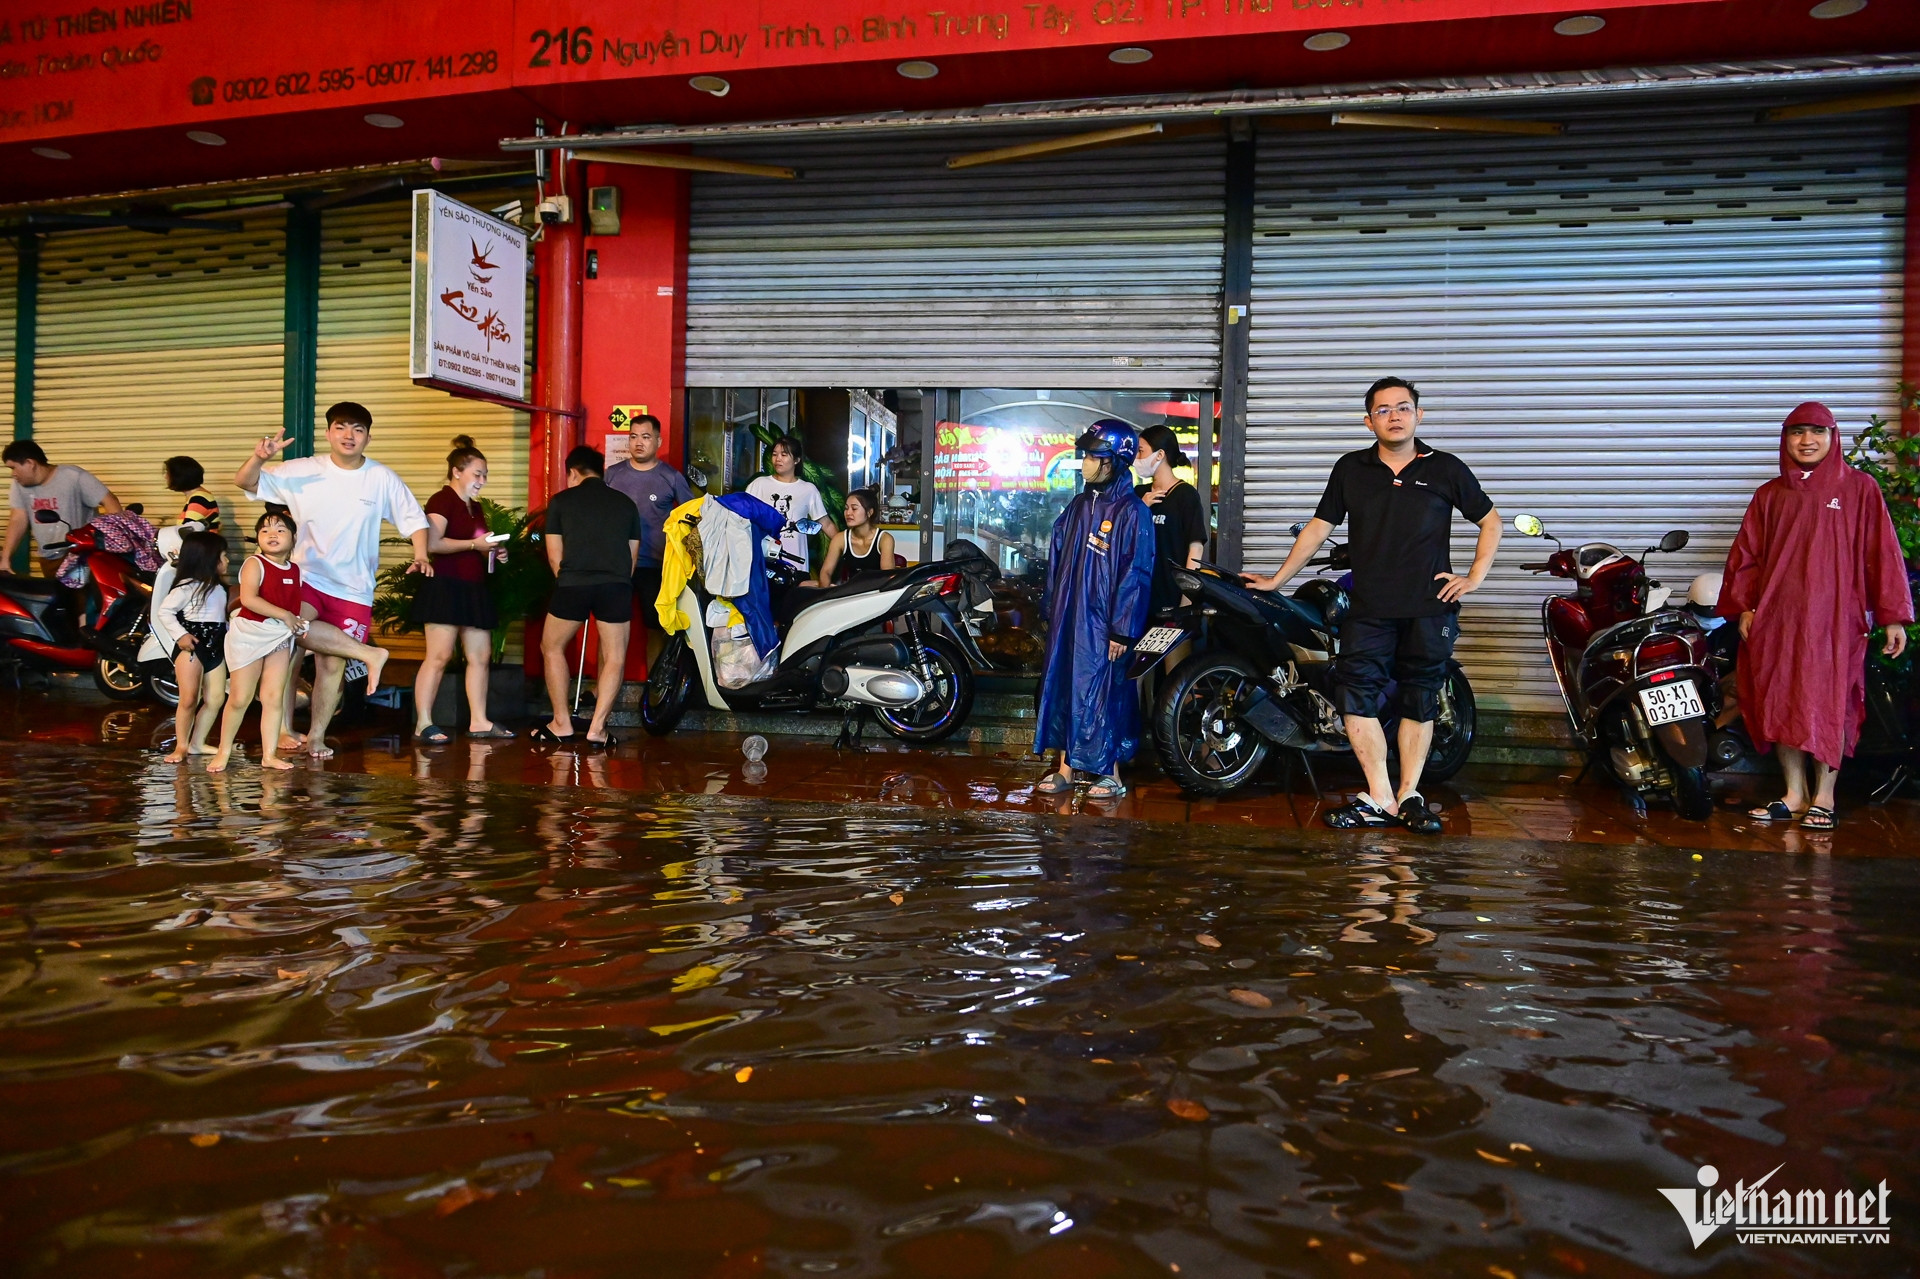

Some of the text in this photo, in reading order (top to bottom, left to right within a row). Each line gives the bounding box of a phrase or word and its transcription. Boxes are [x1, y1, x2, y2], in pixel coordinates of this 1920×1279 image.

[56, 6, 117, 38] THIÊN
[125, 0, 193, 28] NHIÊN
[528, 26, 593, 68] 216
[700, 29, 748, 58] Duy
[861, 14, 917, 42] Bình
[438, 205, 454, 219] YẾN
[502, 232, 521, 249] HẠNG
[467, 281, 479, 294] Yến
[440, 287, 480, 322] Kim
[611, 414, 625, 423] 216
[1648, 684, 1688, 705] 50-X1
[1649, 699, 1700, 722] 032.20
